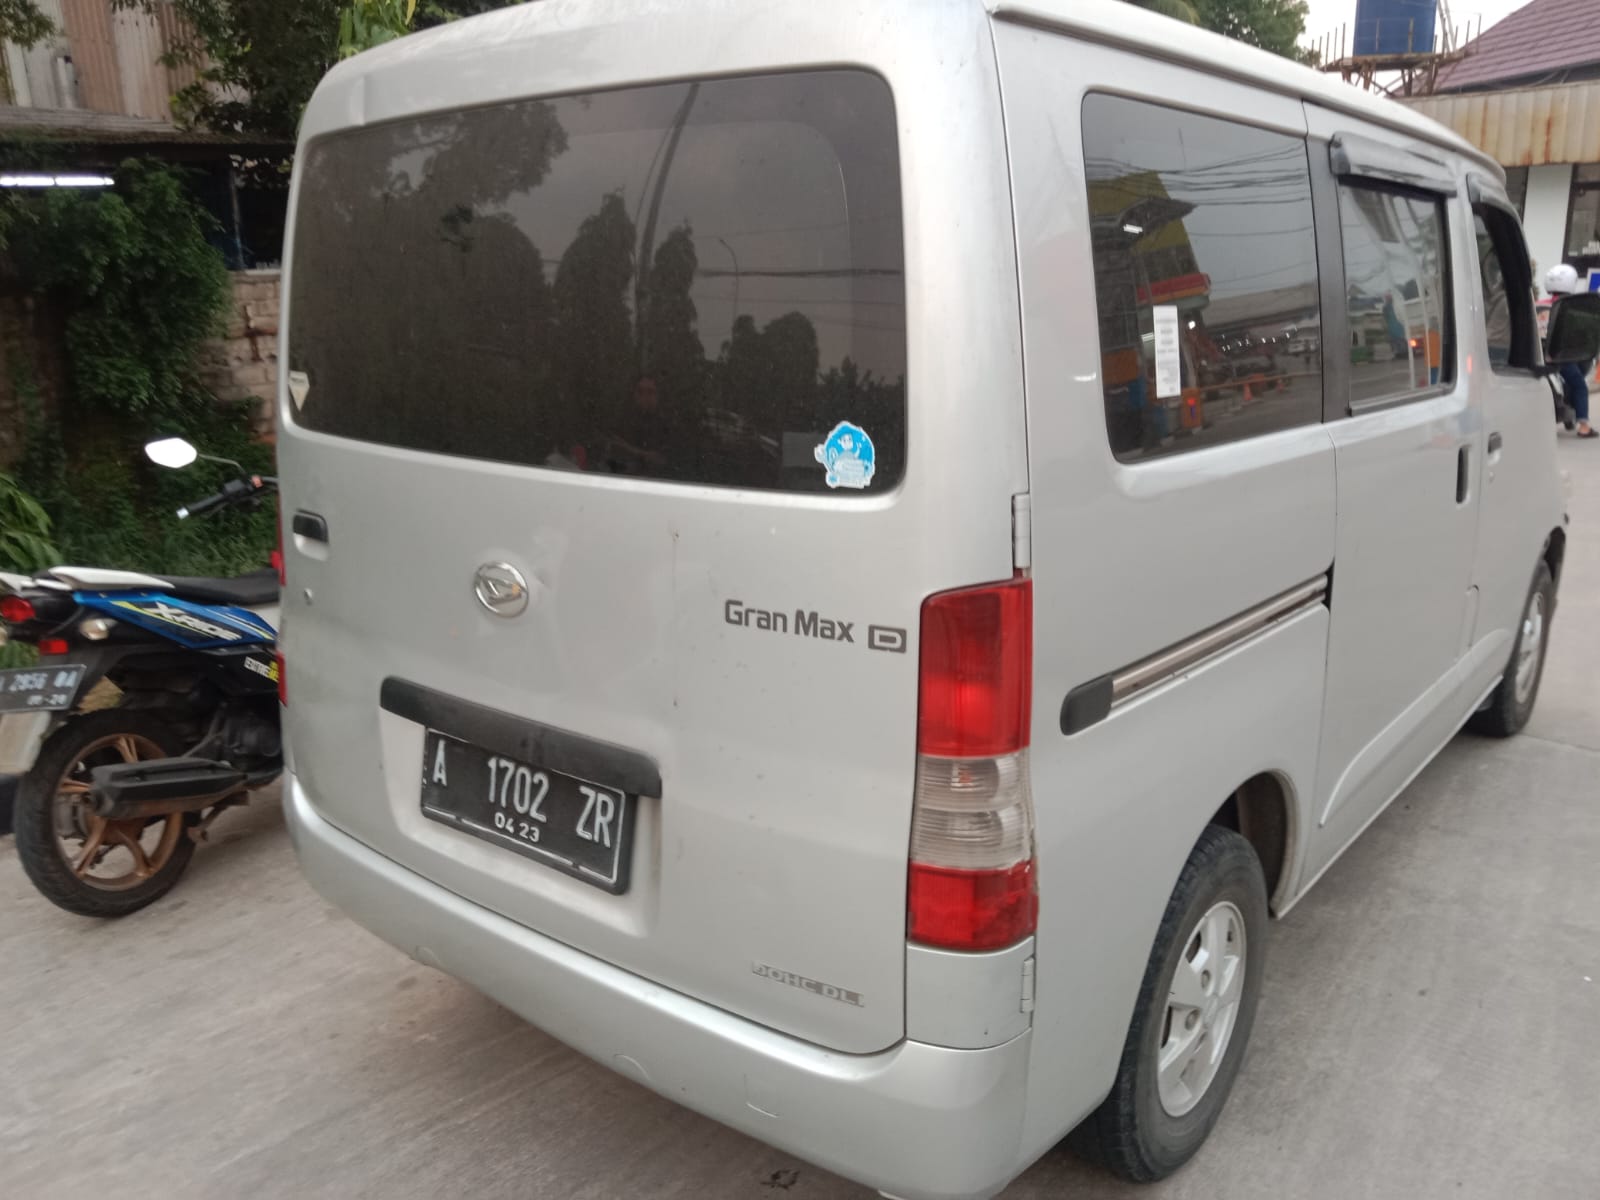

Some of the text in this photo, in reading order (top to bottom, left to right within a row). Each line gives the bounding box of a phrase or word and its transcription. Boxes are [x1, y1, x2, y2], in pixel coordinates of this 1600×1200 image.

[725, 599, 788, 633] Gran
[795, 609, 855, 643] Max
[433, 739, 615, 848] A 1702 ZR
[495, 812, 539, 842] 04 23
